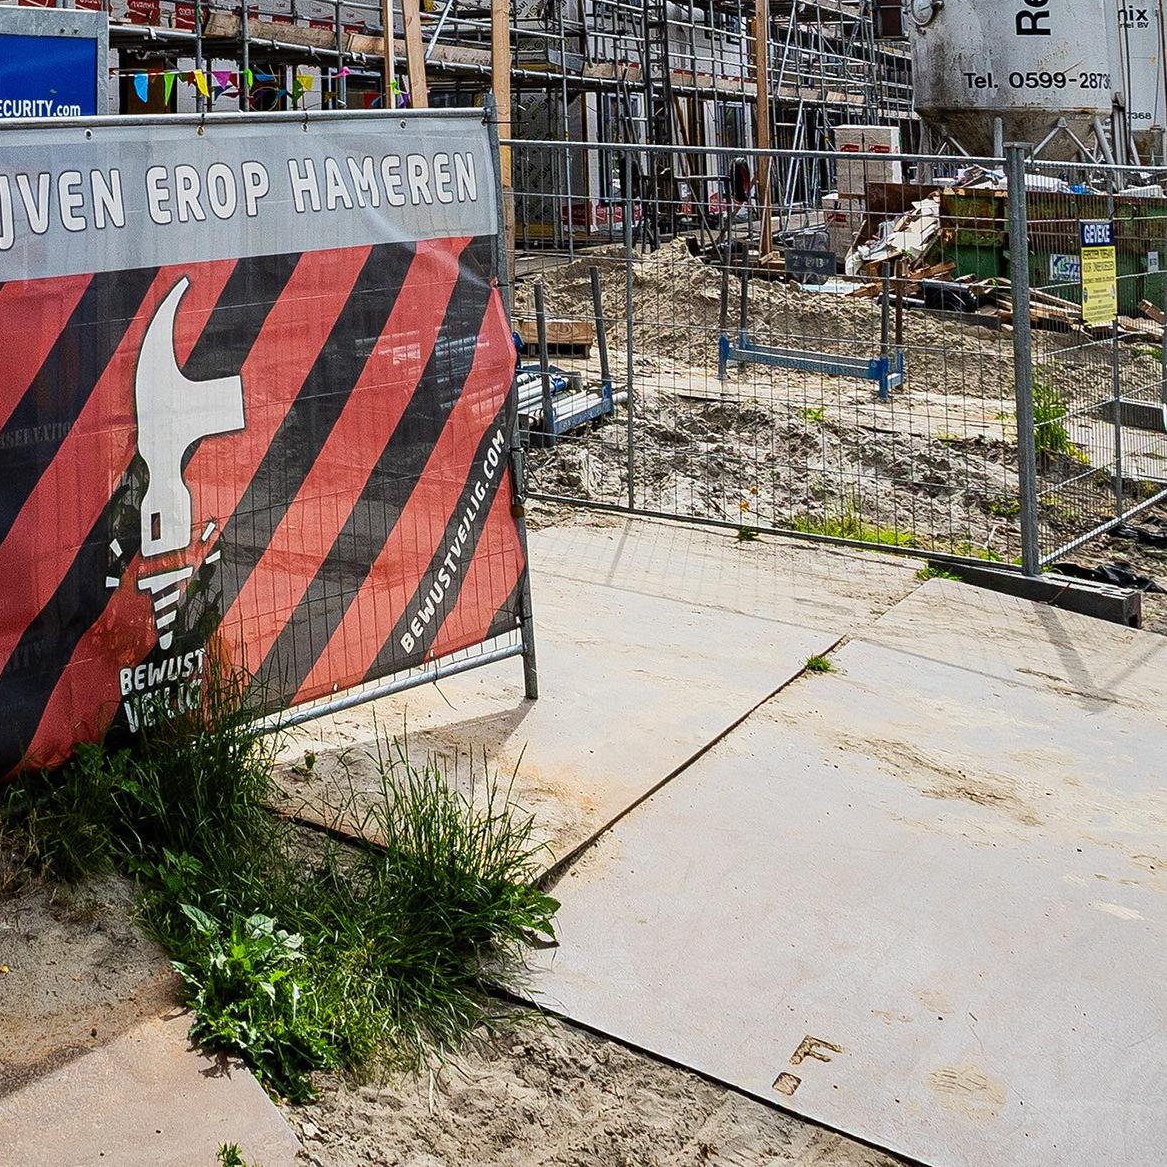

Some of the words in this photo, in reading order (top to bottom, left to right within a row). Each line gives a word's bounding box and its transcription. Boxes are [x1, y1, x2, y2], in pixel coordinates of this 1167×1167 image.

[964, 72, 998, 88] Tel.
[146, 160, 270, 225] EROP
[287, 152, 478, 213] HAMEREN
[1083, 224, 1111, 244] GEVEKE
[400, 429, 506, 655] BEWUSTVEILIG.COM
[119, 648, 206, 696] BEWUST
